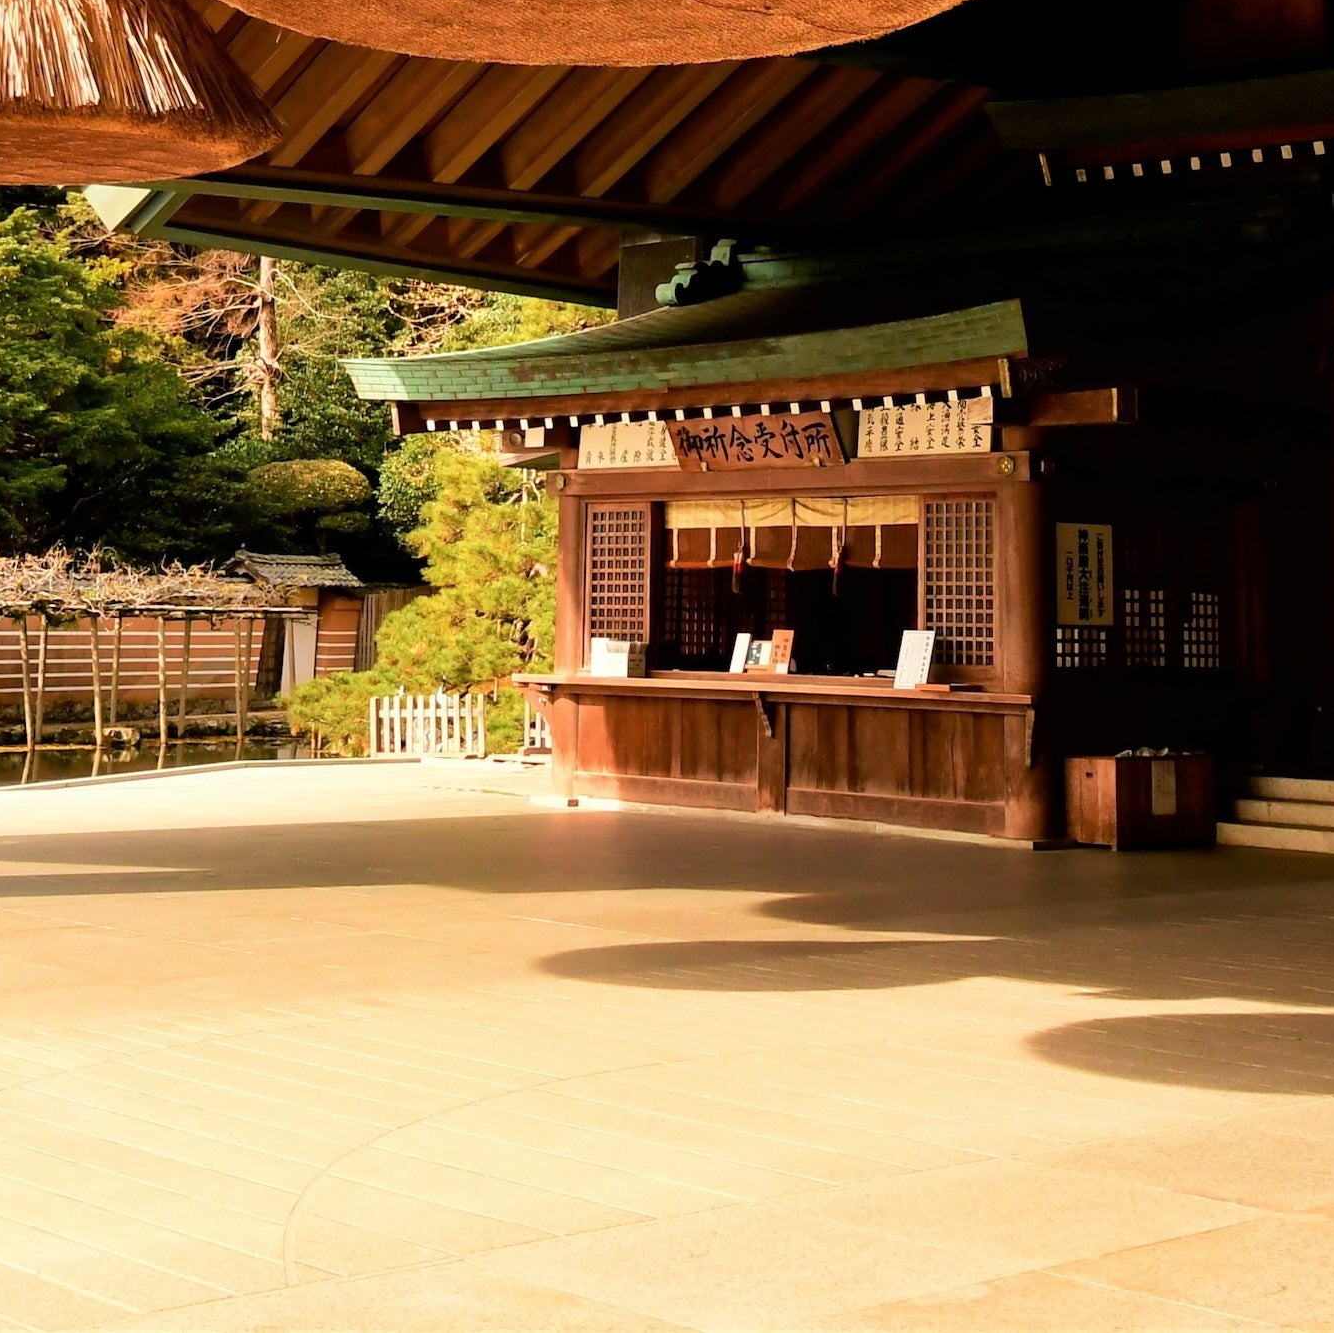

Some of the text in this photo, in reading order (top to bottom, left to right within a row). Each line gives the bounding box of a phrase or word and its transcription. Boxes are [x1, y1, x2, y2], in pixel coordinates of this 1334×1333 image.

[676, 419, 832, 463] 御祈念受付所
[970, 424, 984, 448] 安全
